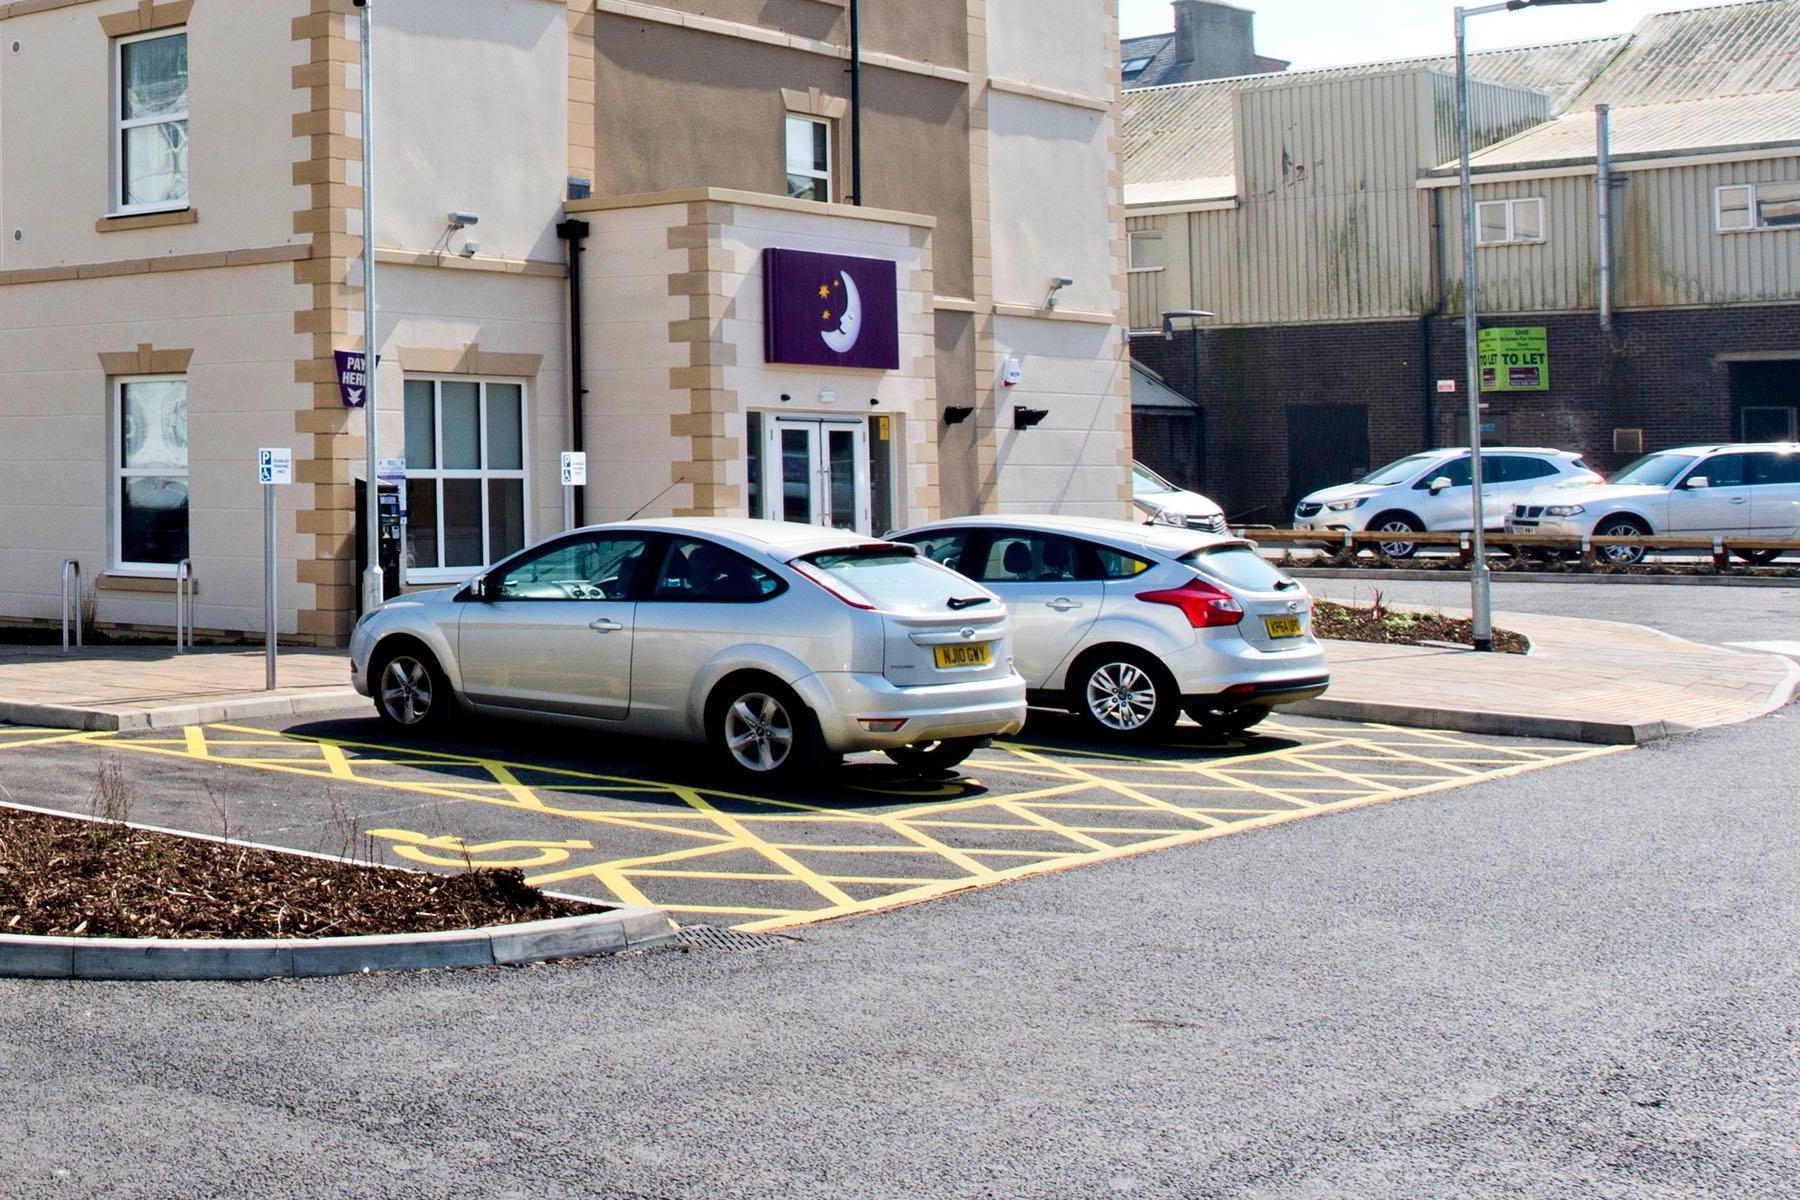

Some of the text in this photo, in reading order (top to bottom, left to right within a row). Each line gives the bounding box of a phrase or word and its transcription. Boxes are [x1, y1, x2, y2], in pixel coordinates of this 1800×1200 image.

[347, 357, 366, 370] PAY
[1502, 353, 1546, 365] TO LET
